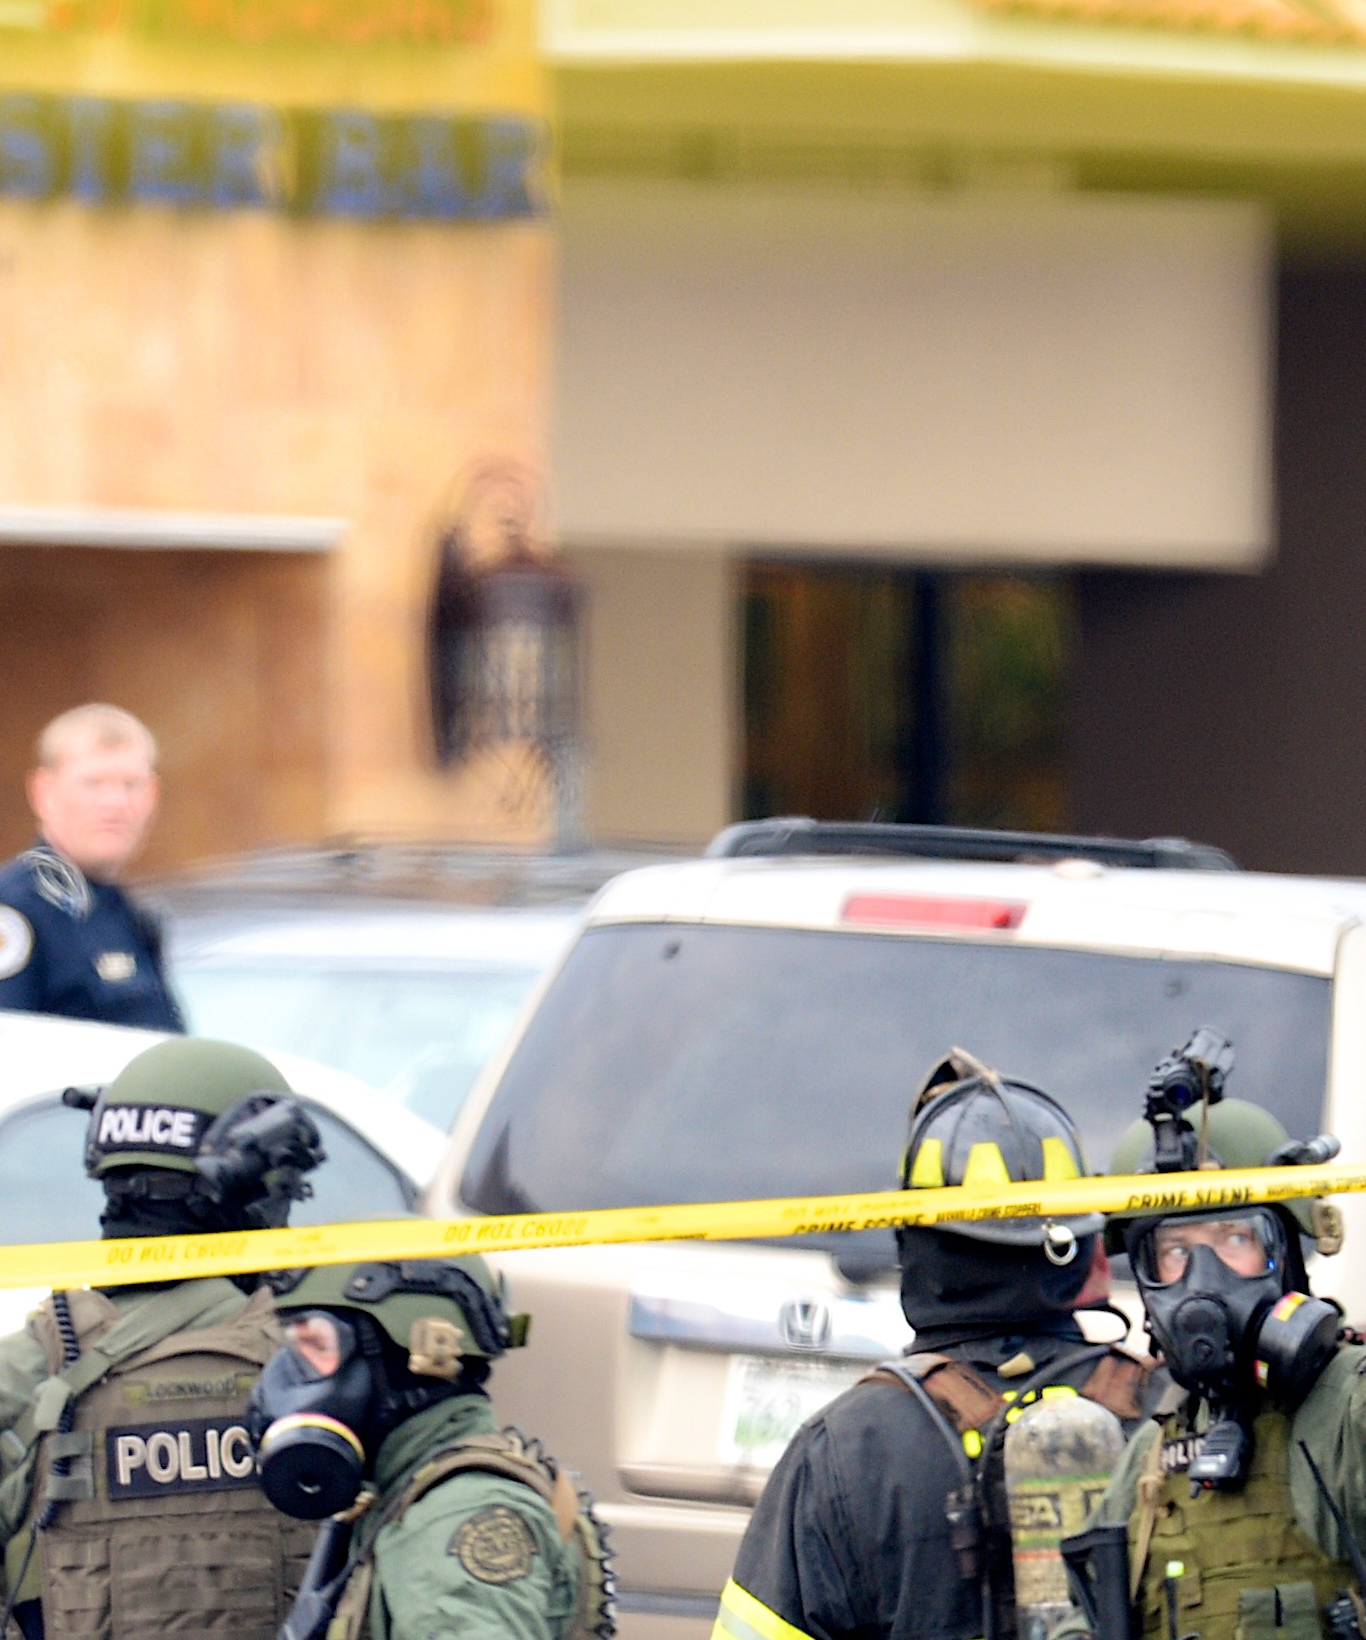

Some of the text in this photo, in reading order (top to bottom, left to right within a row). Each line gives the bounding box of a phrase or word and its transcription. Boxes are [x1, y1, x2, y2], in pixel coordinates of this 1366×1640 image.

[321, 108, 551, 220] BAR
[97, 1108, 195, 1148] POLICE
[1126, 1186, 1254, 1210] CRIME SCENE
[117, 1426, 262, 1485] POLIC
